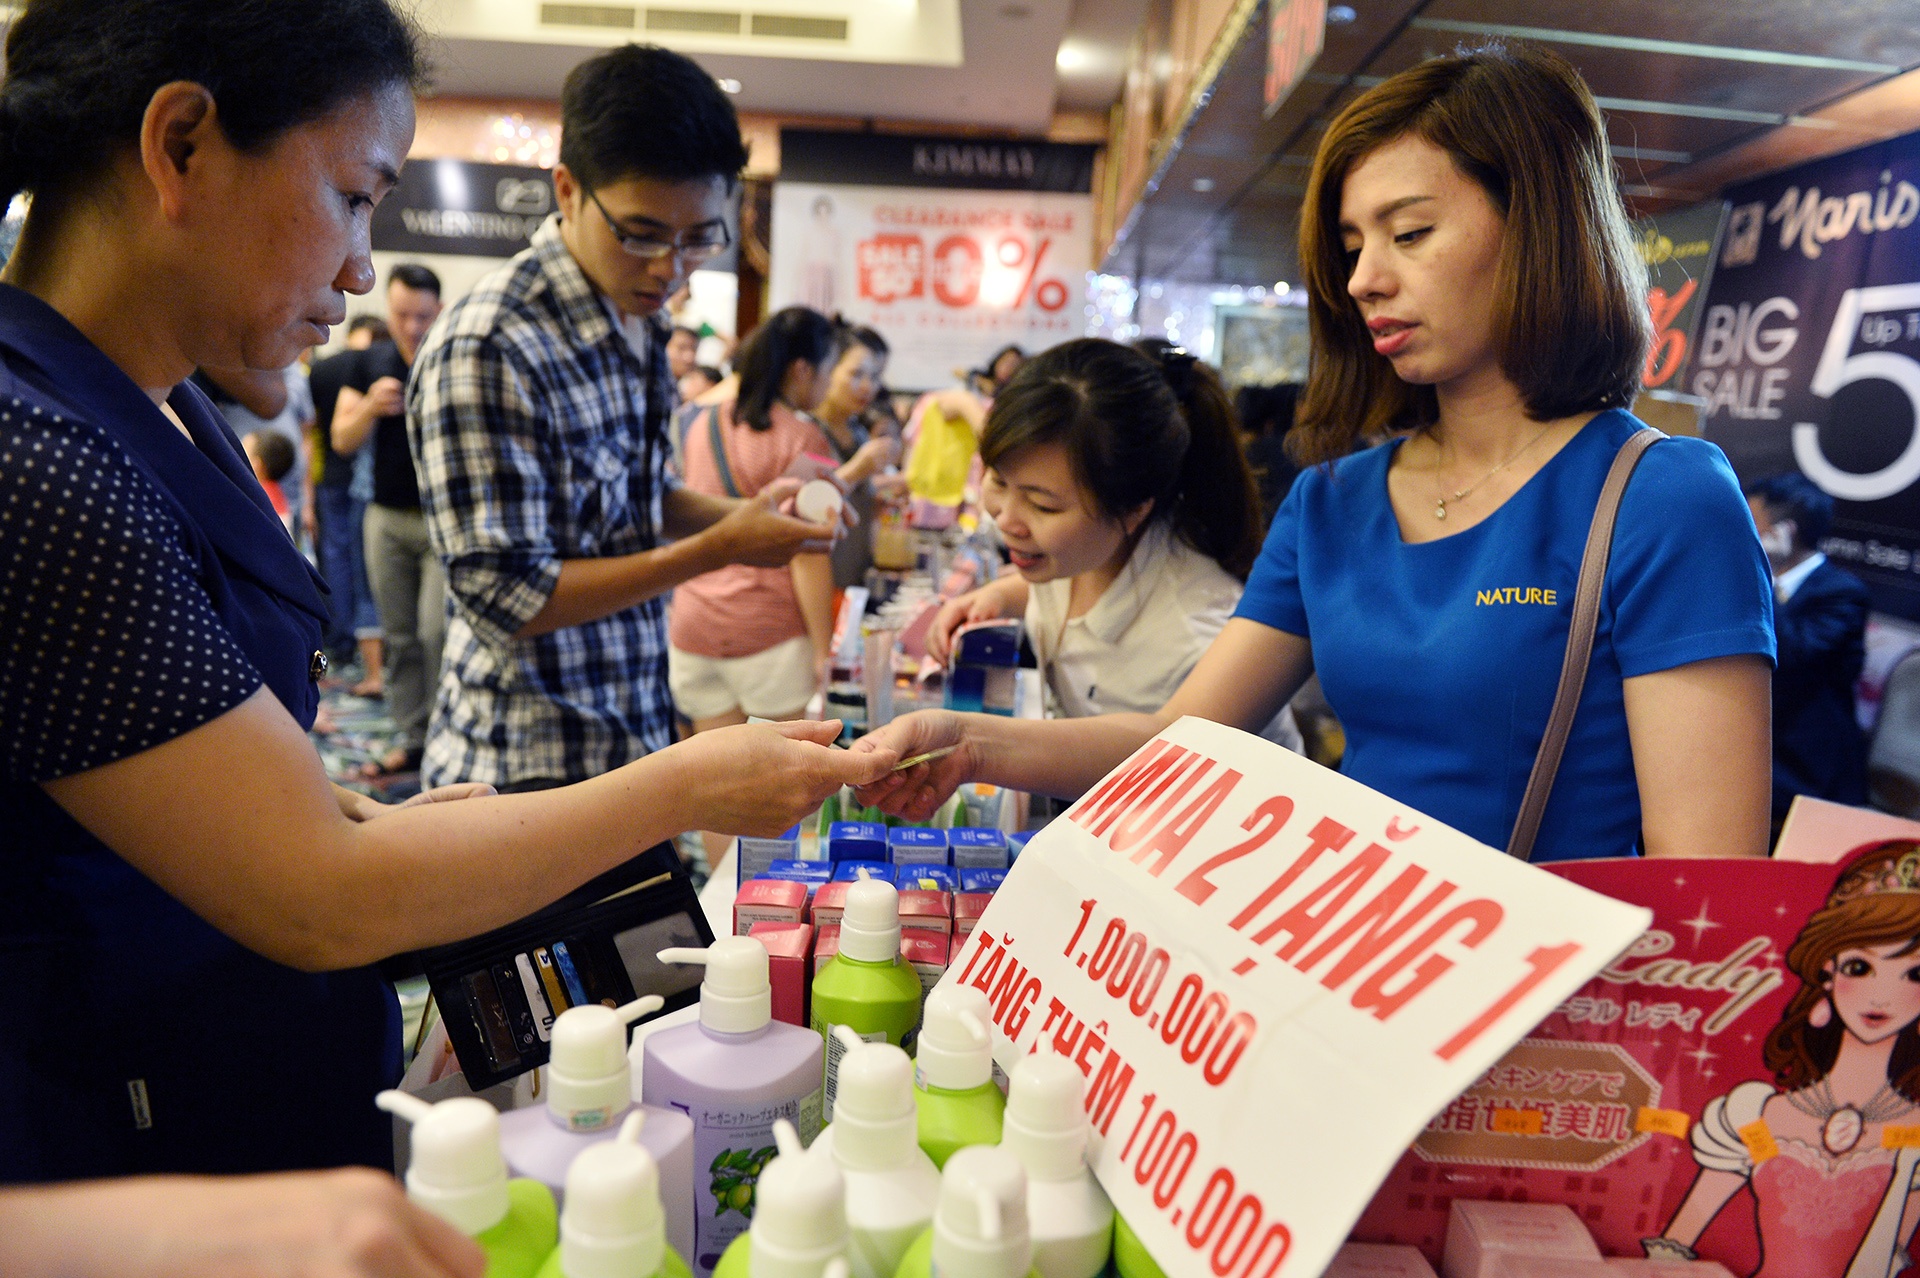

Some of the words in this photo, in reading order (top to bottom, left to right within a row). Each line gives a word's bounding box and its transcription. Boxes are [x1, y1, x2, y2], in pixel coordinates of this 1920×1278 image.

[1701, 296, 1800, 368] BIG
[1692, 367, 1791, 420] SALE
[1475, 587, 1558, 606] NATURE
[1068, 738, 1244, 878] MUA
[1173, 794, 1295, 906] 2
[1433, 940, 1584, 1063] 1
[1063, 897, 1259, 1087] 1.000.000
[1596, 929, 1783, 1034] Lady
[1120, 1093, 1292, 1278] 100.000
